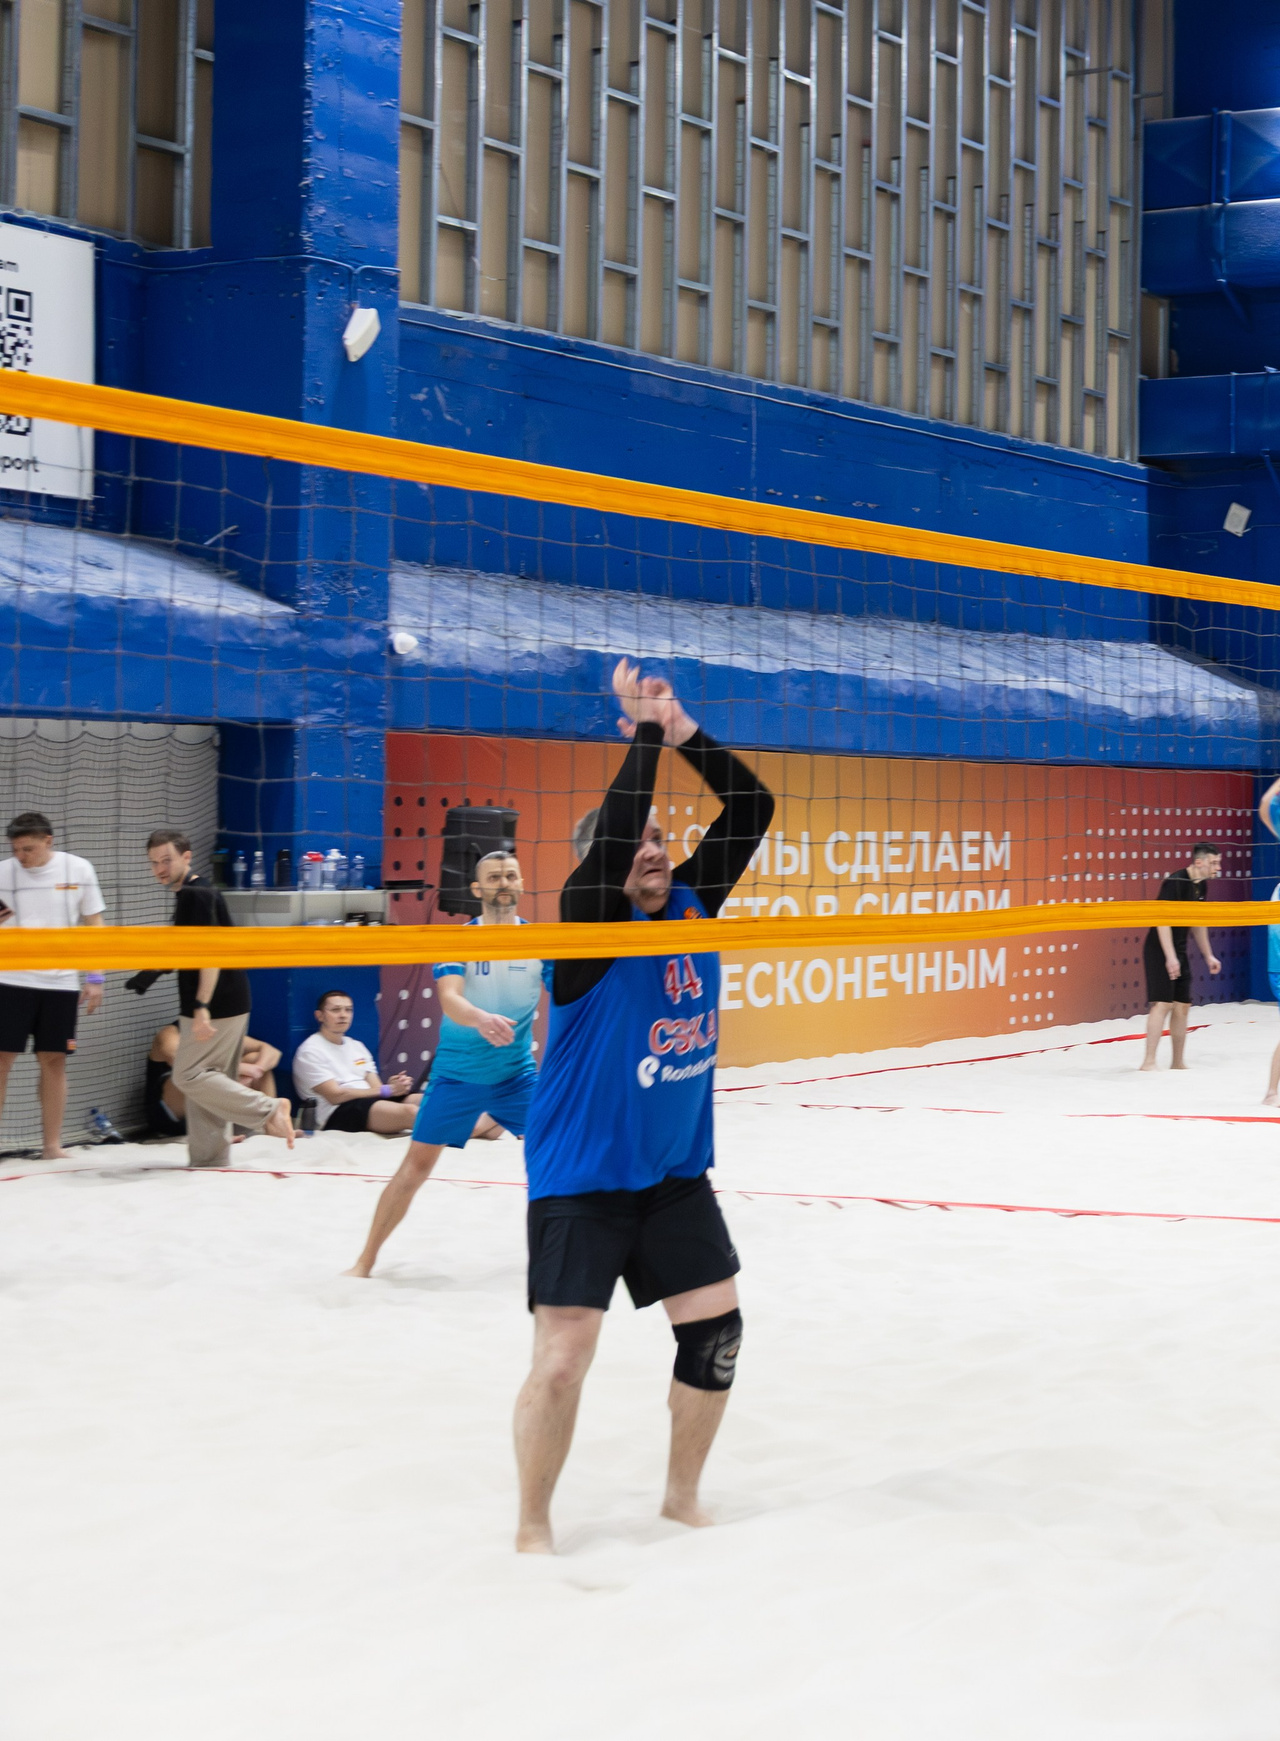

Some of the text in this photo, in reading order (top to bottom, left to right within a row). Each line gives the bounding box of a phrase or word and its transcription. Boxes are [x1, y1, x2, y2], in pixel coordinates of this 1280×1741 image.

[824, 831, 1011, 882] СДЕЛАЕМ
[664, 955, 703, 1005] 44
[719, 947, 1007, 1011] ЕСКОНЕЧНЫМ
